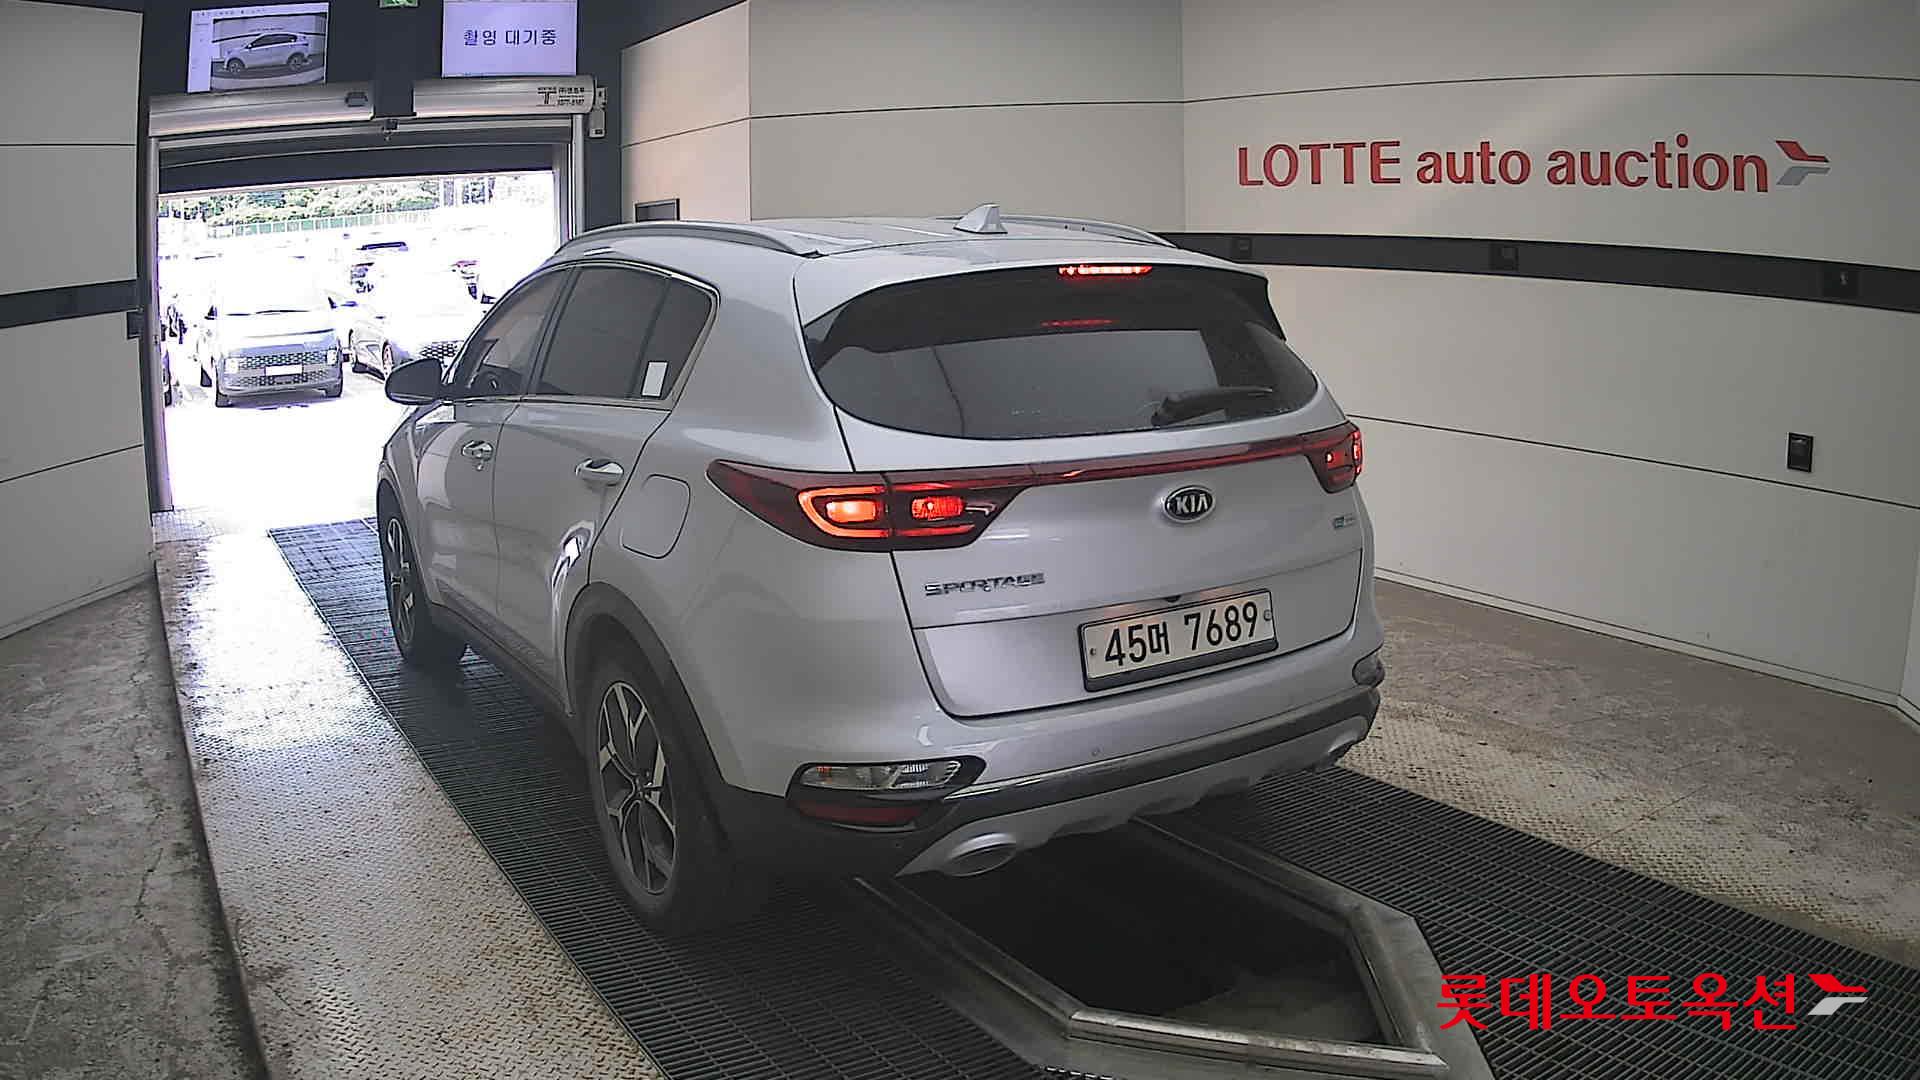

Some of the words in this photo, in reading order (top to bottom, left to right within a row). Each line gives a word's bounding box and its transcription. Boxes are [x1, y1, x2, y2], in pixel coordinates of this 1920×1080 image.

[505, 28, 557, 46] 대기중
[1238, 140, 1400, 187] LOTTE
[1416, 141, 1531, 185] auto
[1546, 133, 1769, 193] auction
[1175, 493, 1208, 515] KIA
[924, 572, 1046, 597] SPORTAGE
[1104, 621, 1170, 667] 45머
[1183, 601, 1258, 651] 7689
